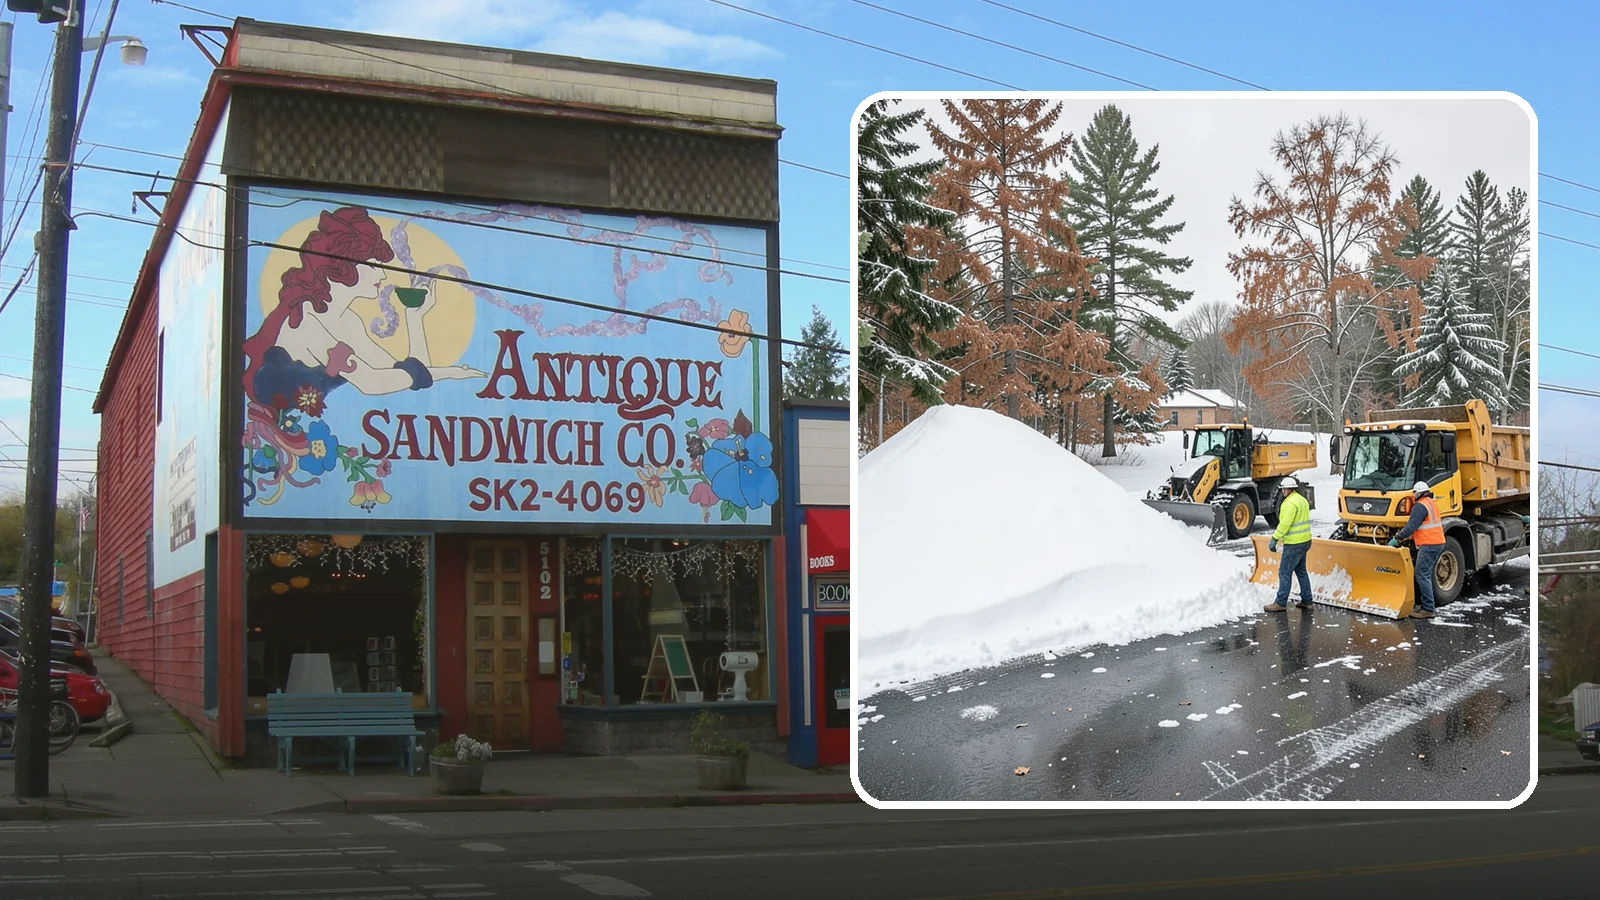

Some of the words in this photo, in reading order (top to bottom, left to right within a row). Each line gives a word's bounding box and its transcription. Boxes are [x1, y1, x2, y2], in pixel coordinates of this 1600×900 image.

[476, 329, 723, 420] ANTIQUE
[361, 408, 605, 467] SANDWICH
[617, 421, 684, 469] CO.
[468, 477, 645, 512] SK2-4069
[539, 542, 551, 599] 5102
[809, 555, 835, 569] BOOKS
